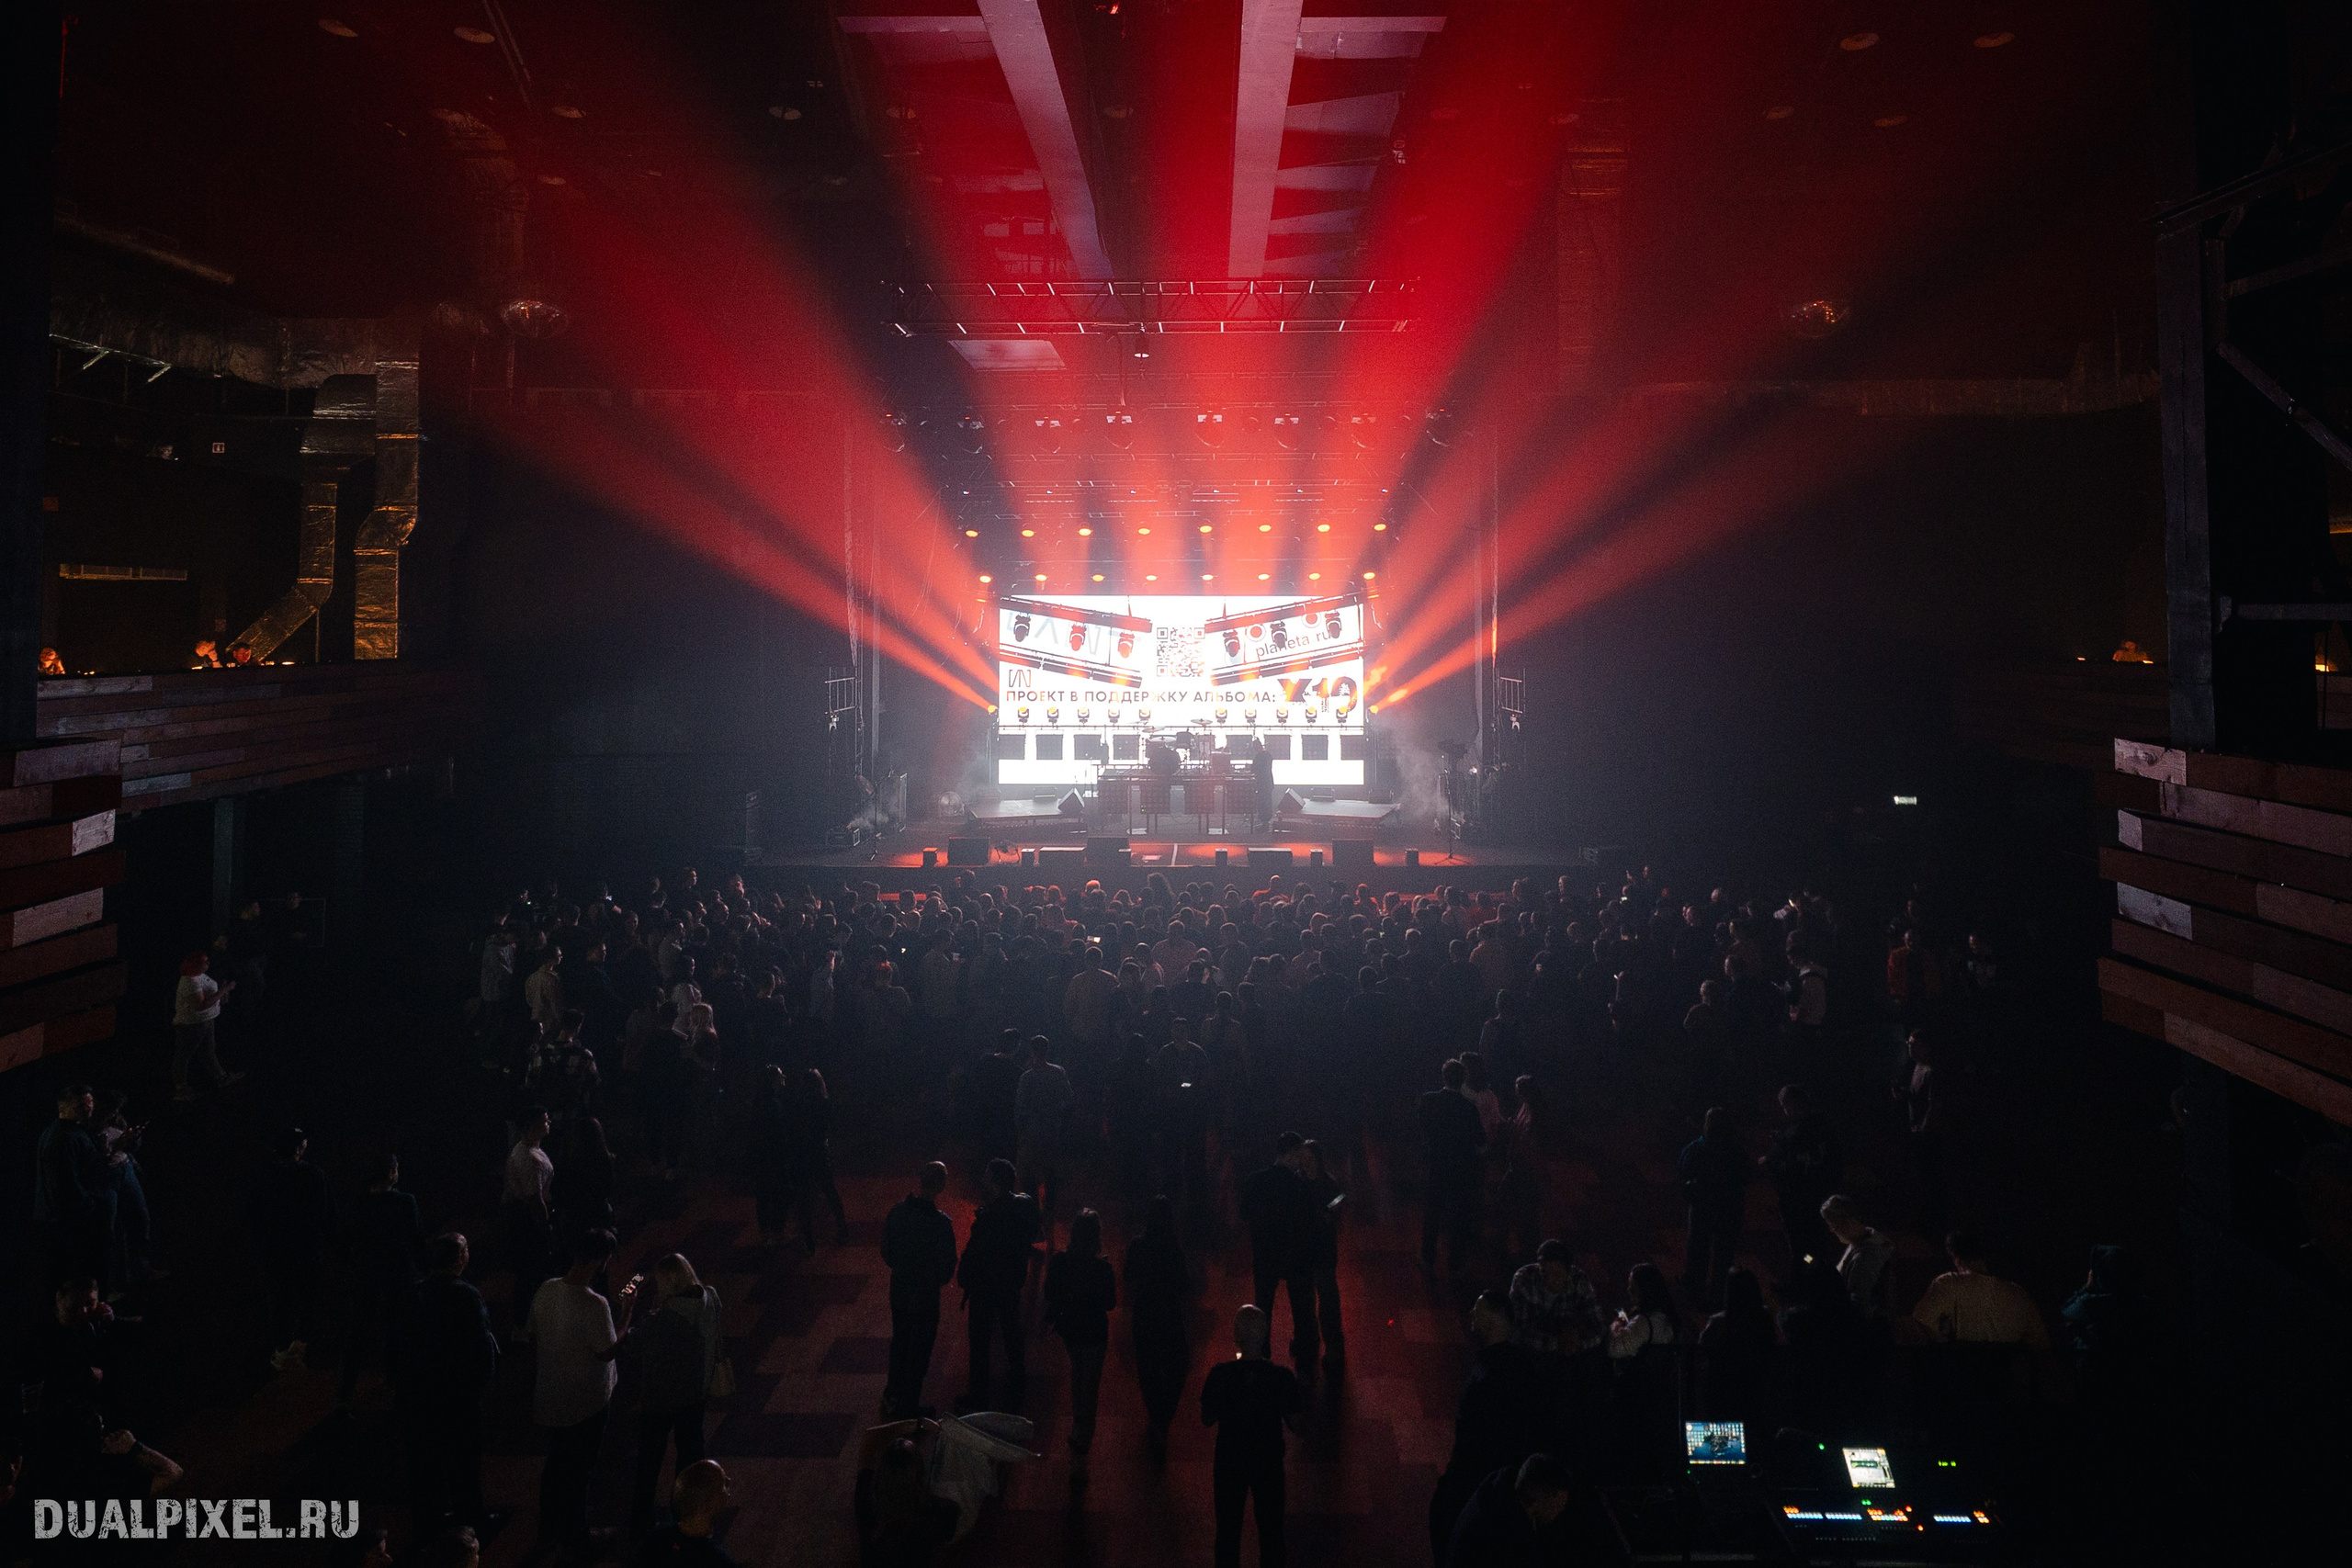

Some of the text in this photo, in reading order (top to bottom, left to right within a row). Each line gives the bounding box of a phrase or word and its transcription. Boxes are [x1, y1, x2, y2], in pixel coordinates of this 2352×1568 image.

[1006, 691, 1065, 702] ПРОЕКТ
[1070, 691, 1079, 702] В
[1085, 691, 1187, 704] ПОДДЕРЖКУ
[1193, 691, 1276, 702] АЛЬБОМА:
